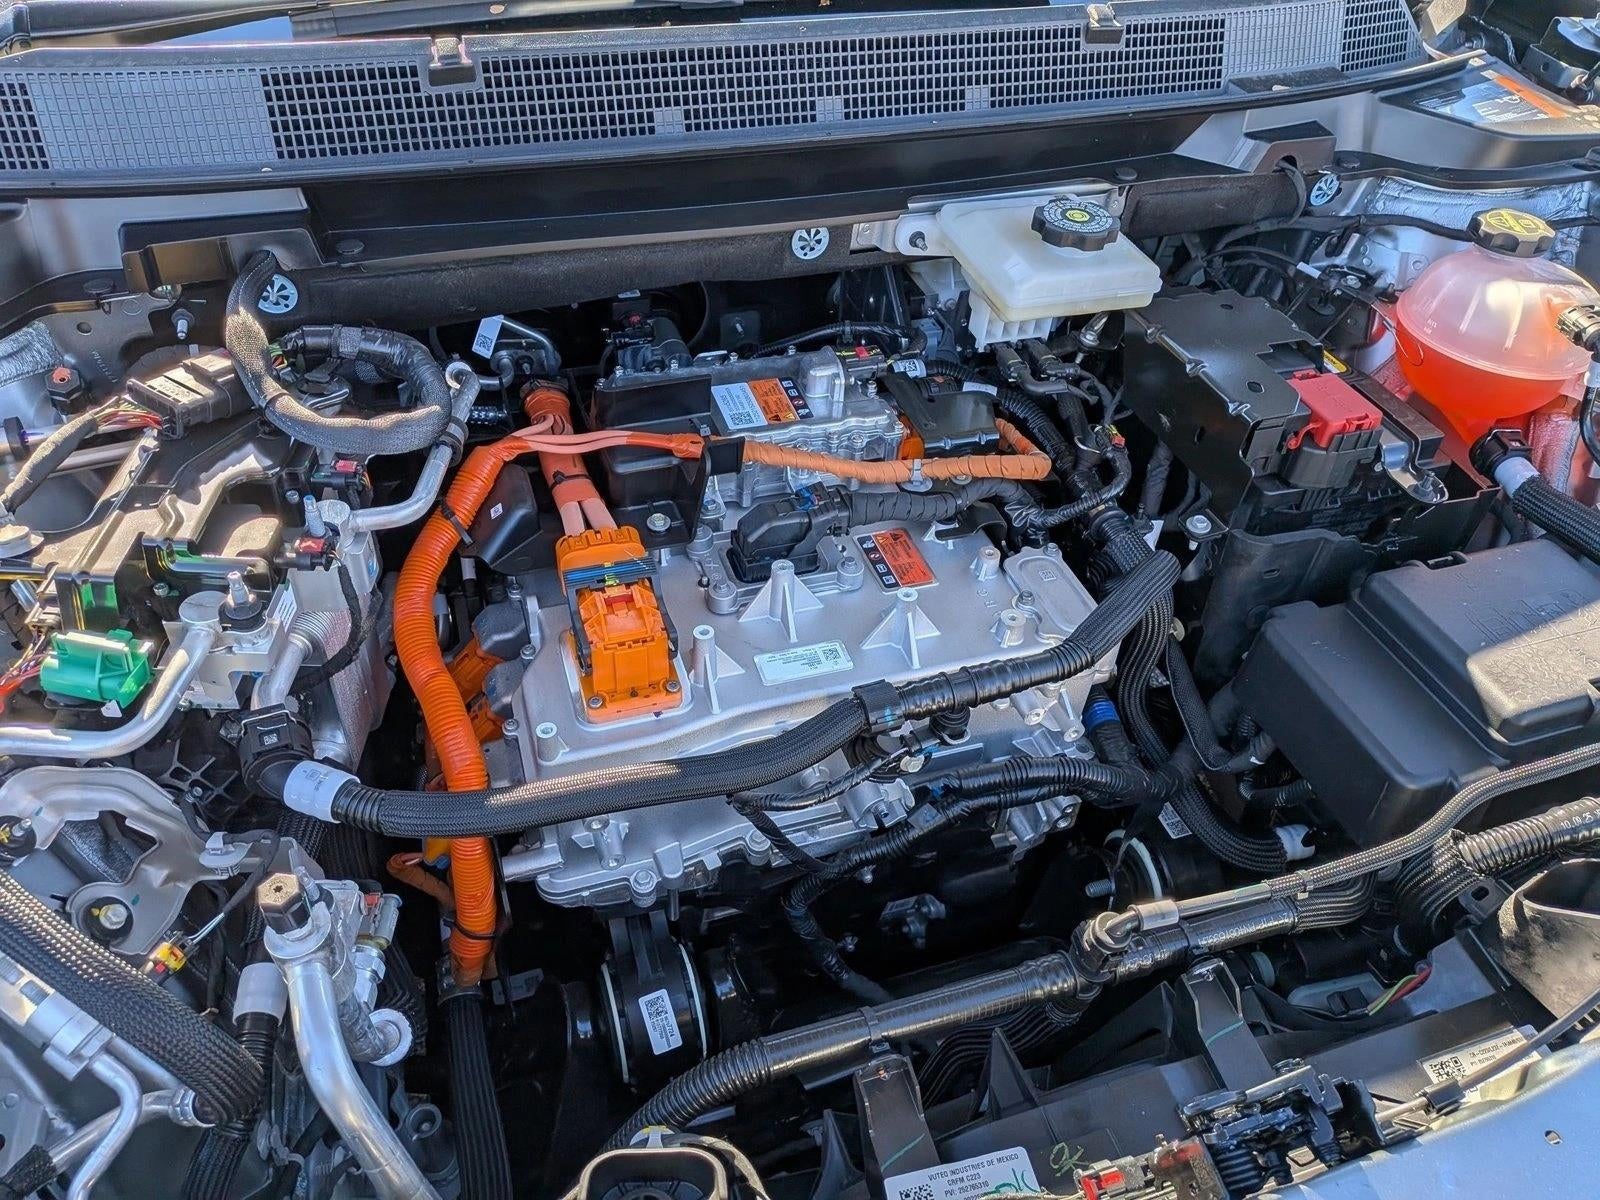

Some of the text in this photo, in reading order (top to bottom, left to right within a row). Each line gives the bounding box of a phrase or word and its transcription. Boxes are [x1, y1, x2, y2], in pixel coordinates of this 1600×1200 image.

[949, 1163, 986, 1175] INDUSTRIES
[986, 1159, 995, 1167] DE
[996, 1153, 1019, 1164] MEXICO
[965, 1172, 982, 1182] C223
